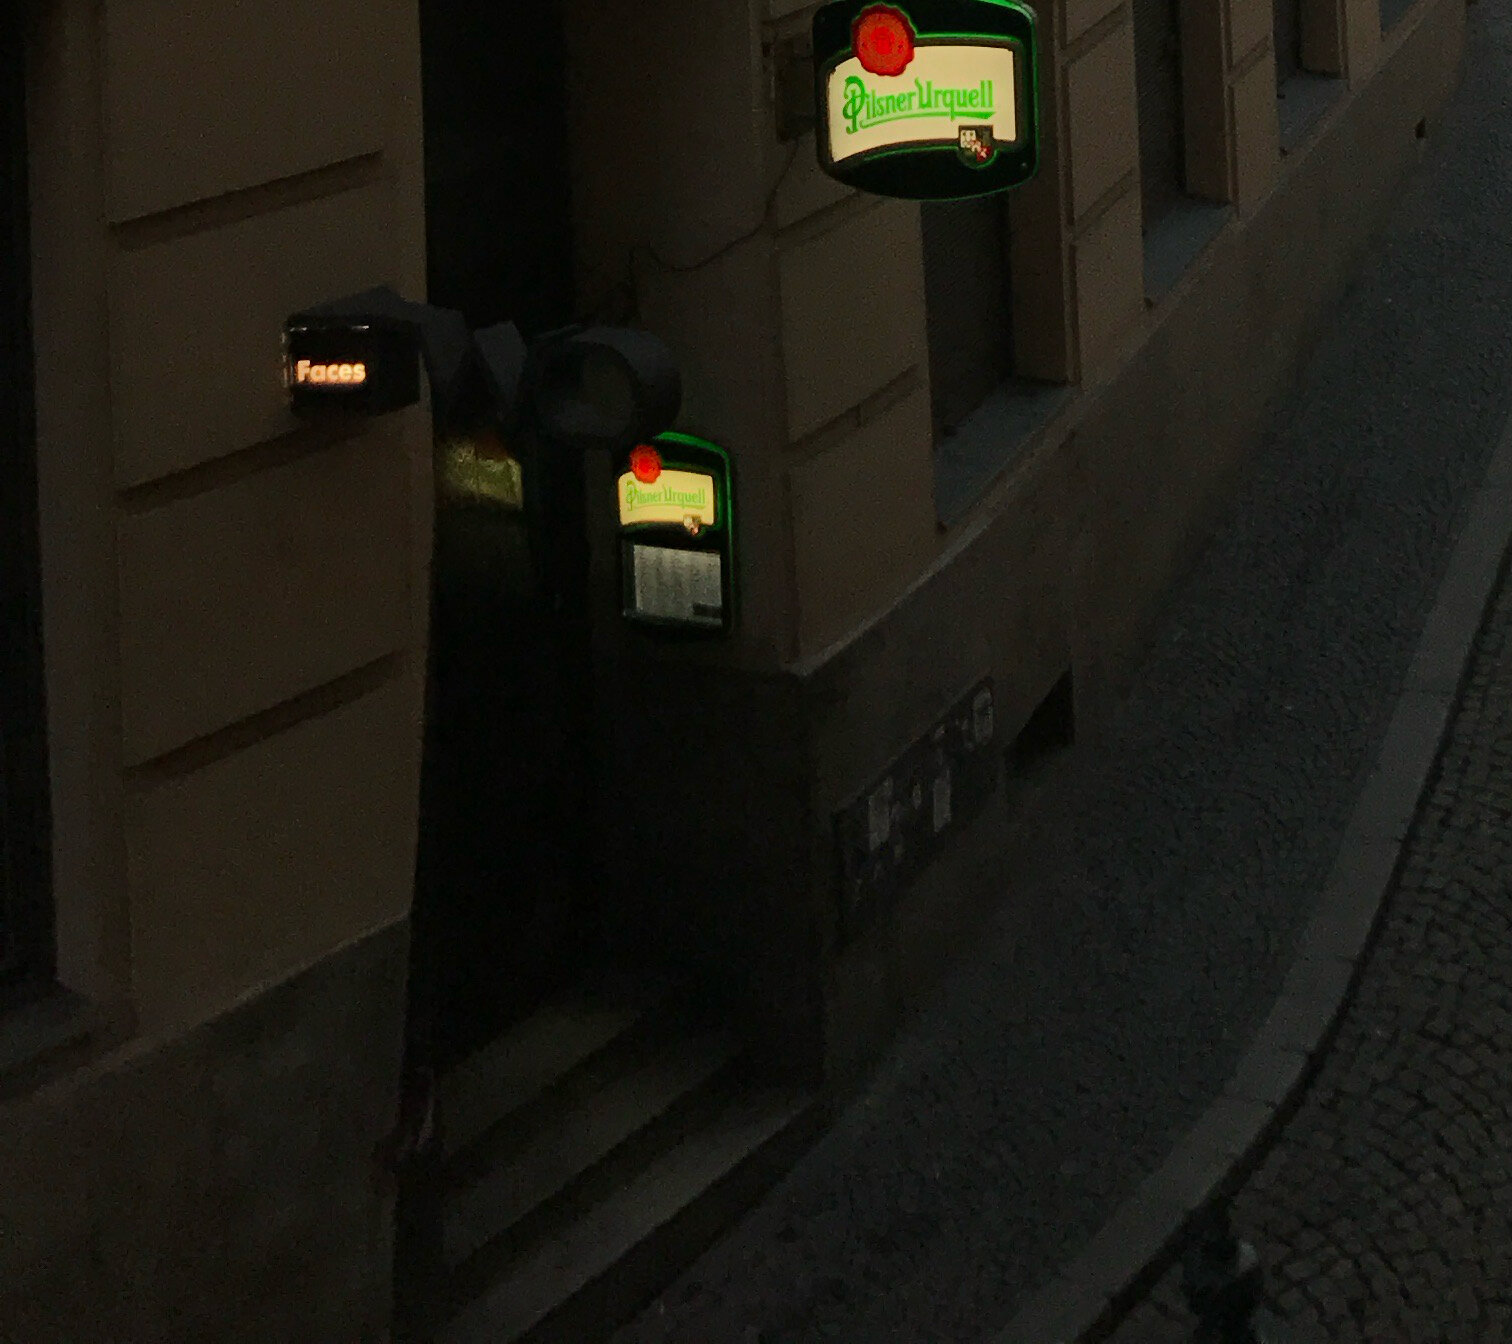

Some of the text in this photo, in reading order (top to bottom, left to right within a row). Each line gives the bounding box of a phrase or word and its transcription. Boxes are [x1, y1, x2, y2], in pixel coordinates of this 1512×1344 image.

[842, 75, 994, 134] Pilsner Urquell
[297, 359, 366, 384] Faces
[662, 484, 705, 508] Urquell
